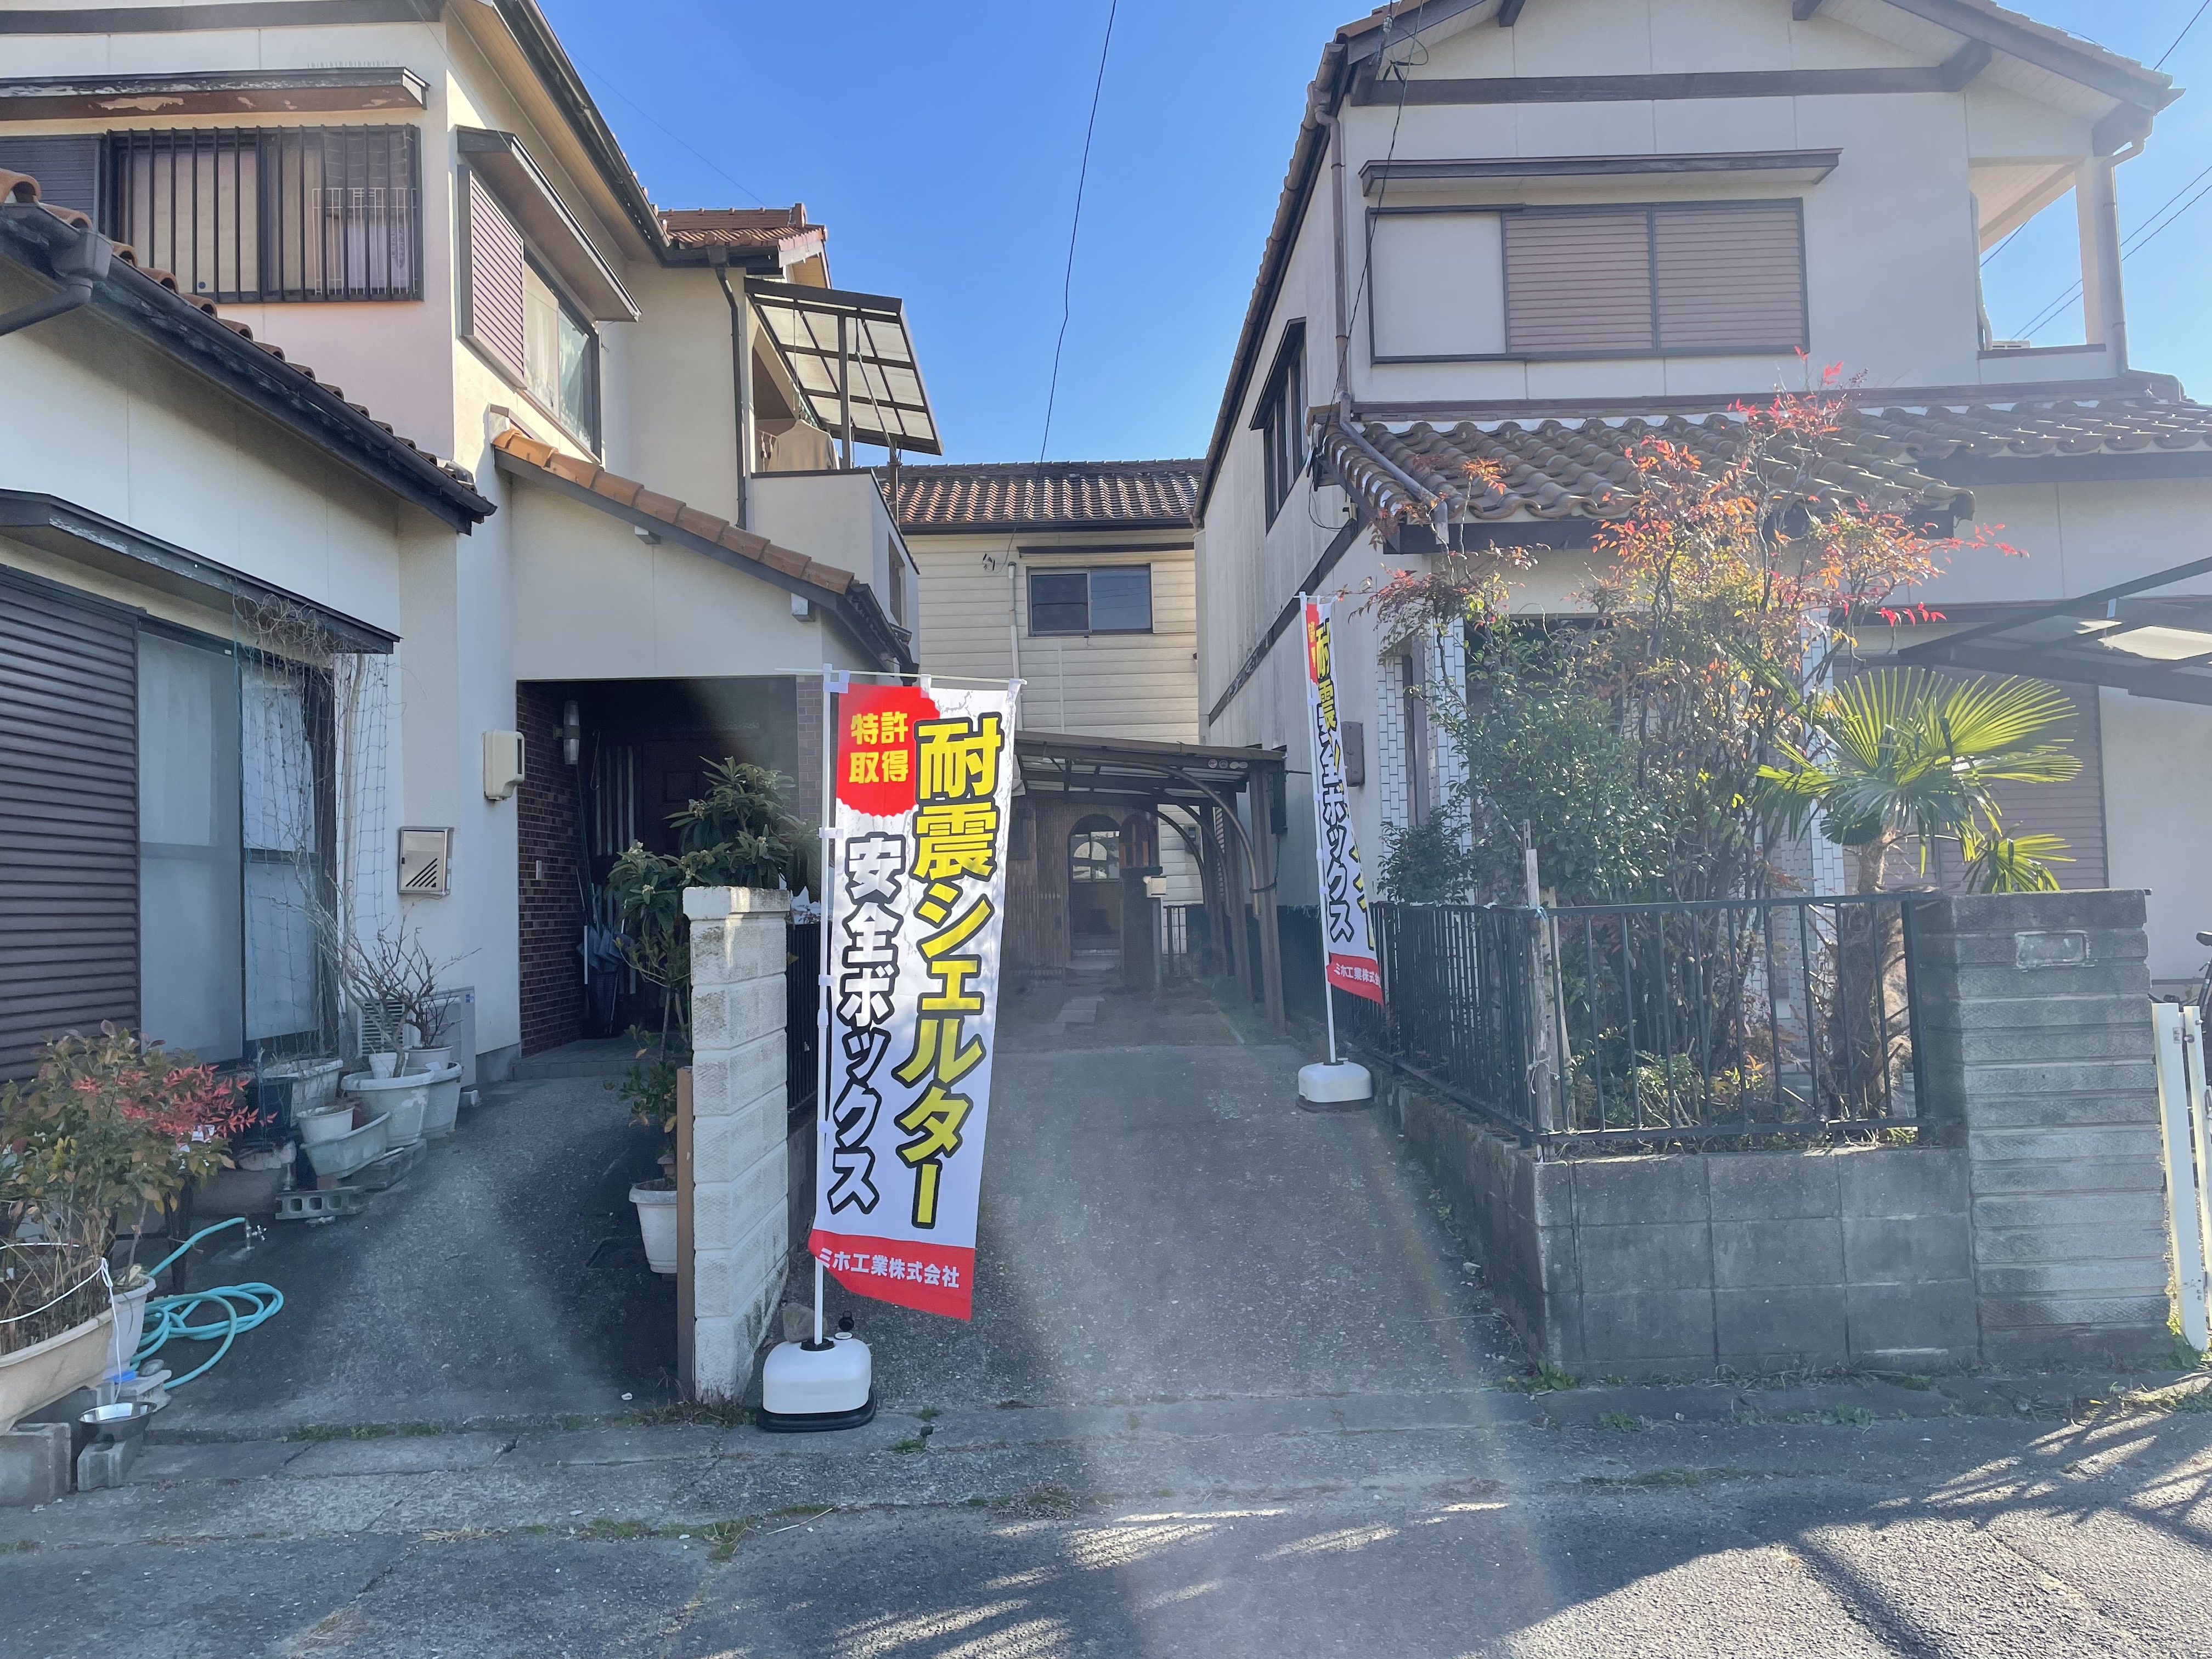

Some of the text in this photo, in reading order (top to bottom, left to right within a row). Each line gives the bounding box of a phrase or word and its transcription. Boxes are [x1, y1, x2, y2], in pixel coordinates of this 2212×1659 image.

[850, 711, 909, 746] 特許
[849, 750, 909, 784] 取得
[827, 832, 905, 1214] 安全ボックス
[819, 1247, 960, 1288] ミホ工業株式会社
